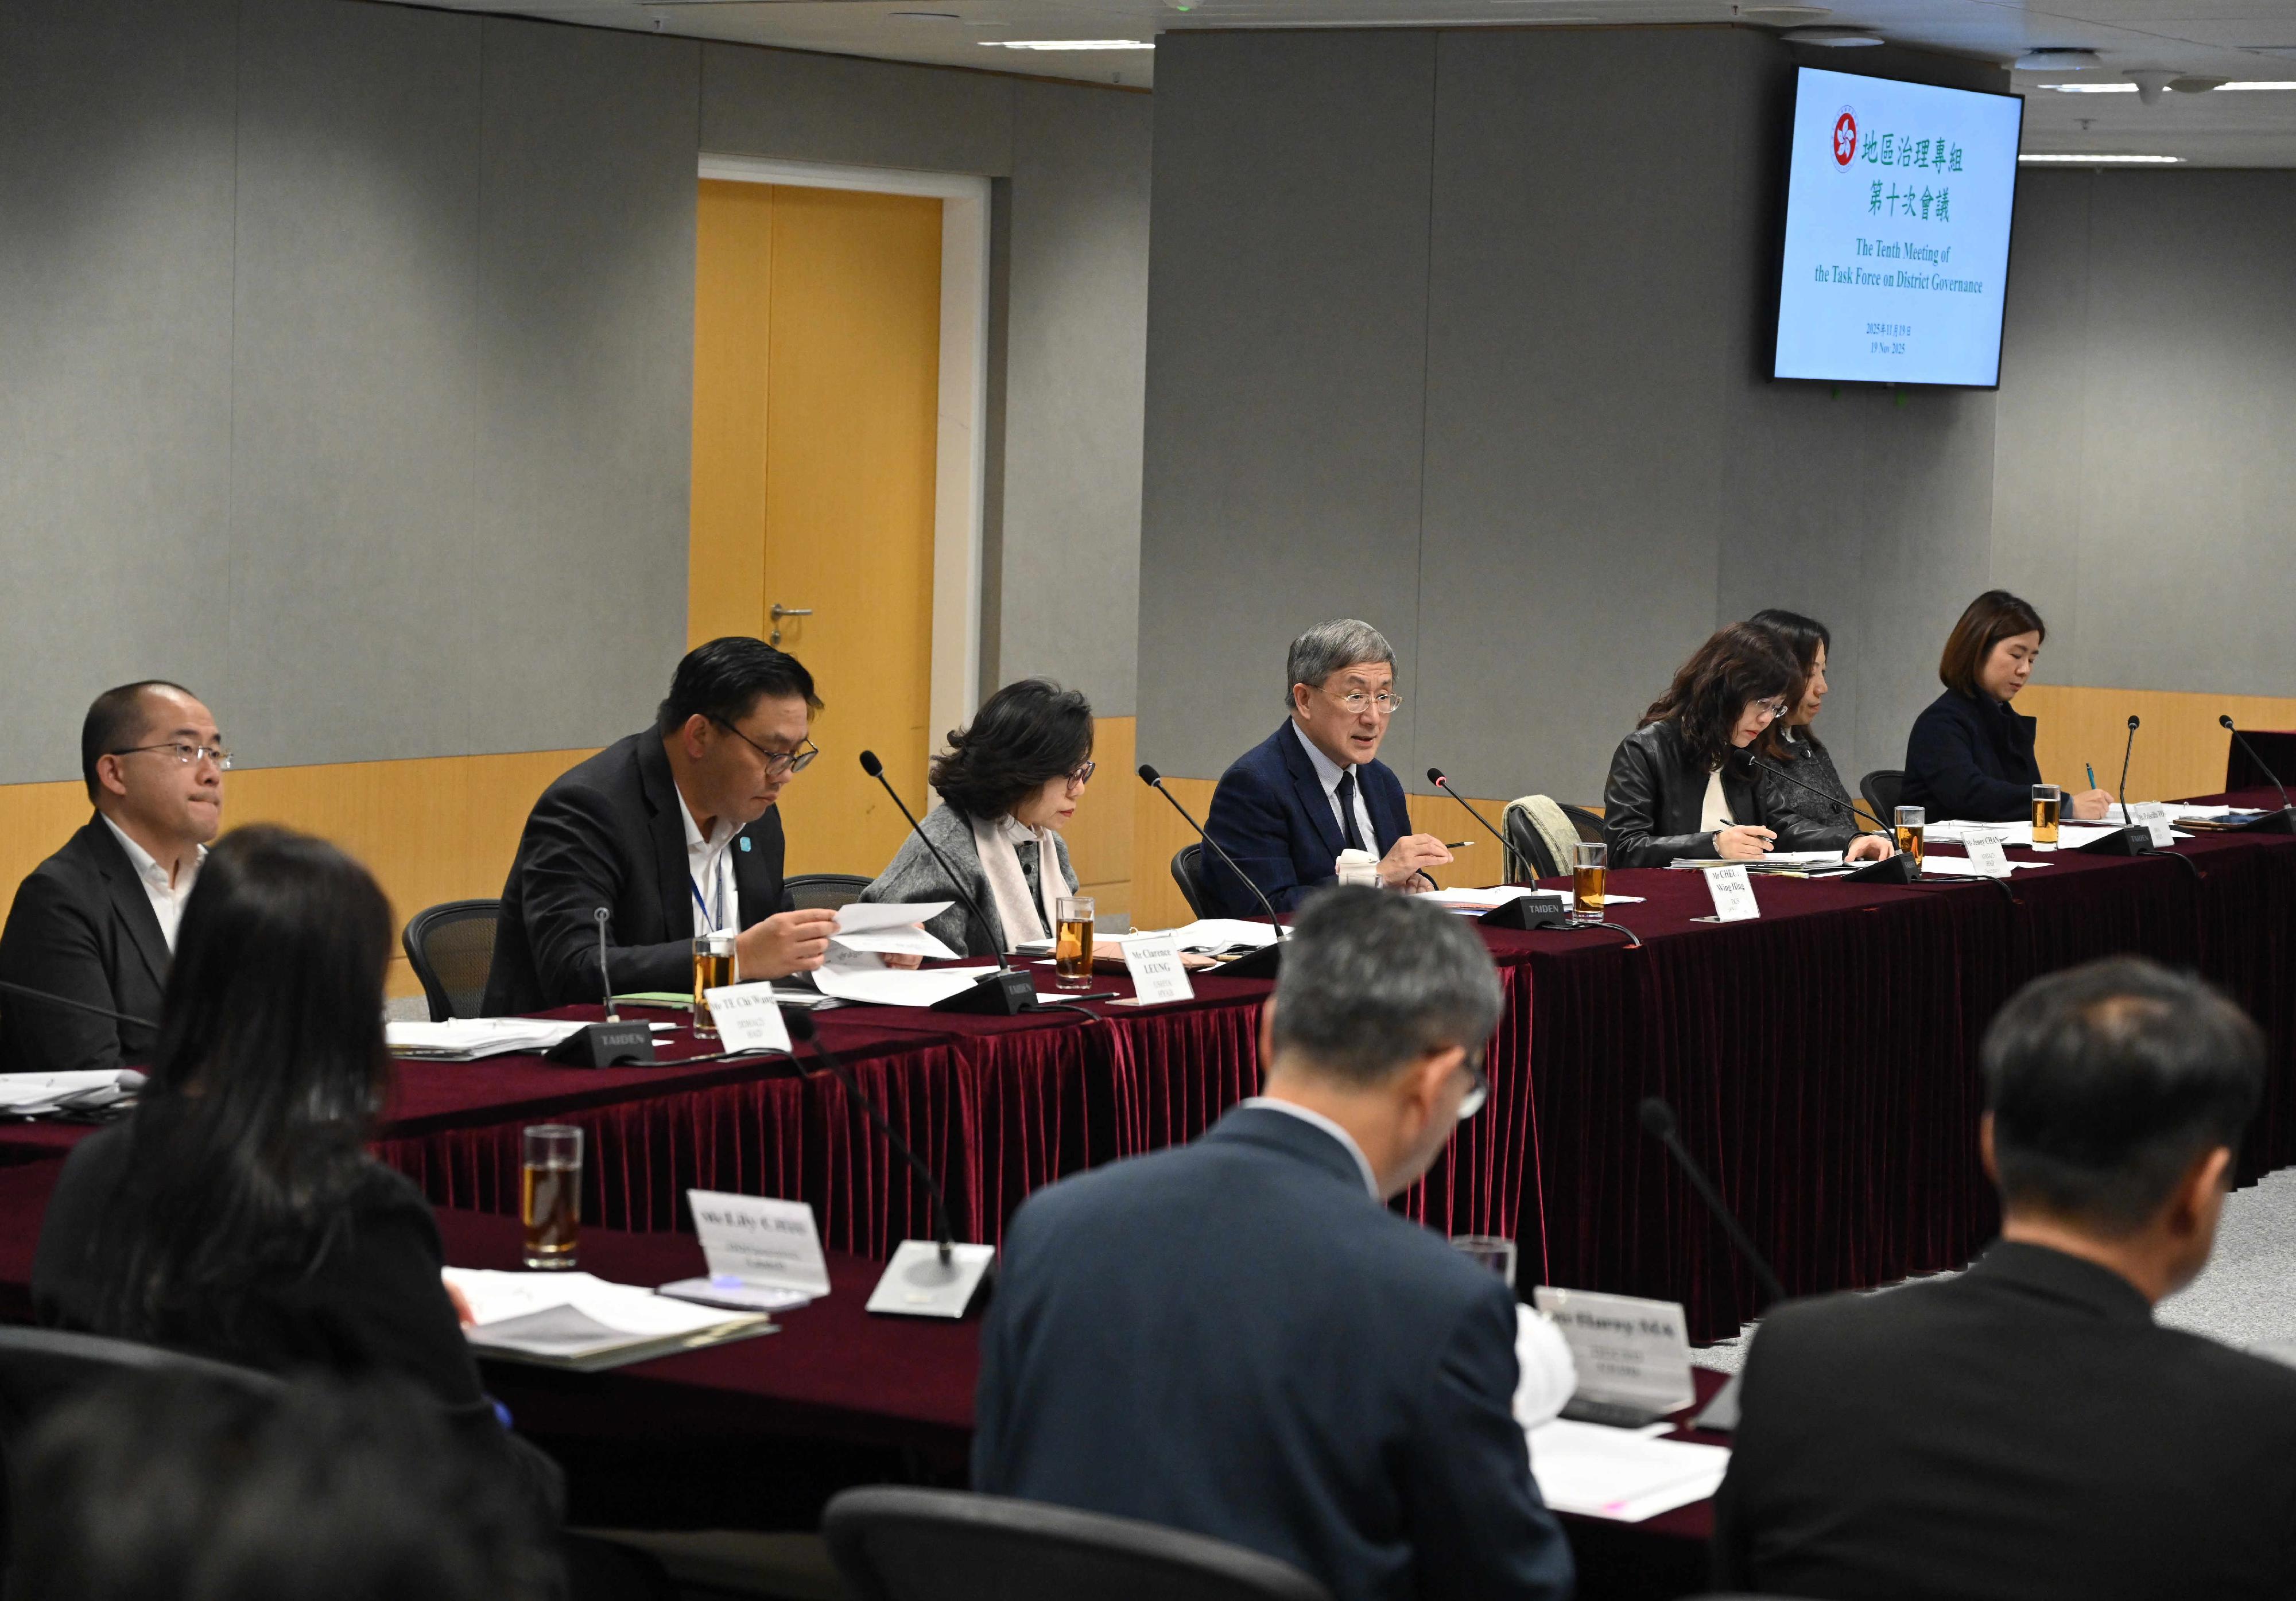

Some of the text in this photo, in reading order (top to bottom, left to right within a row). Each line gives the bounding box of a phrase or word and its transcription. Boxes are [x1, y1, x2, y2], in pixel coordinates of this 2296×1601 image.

[1861, 129, 1963, 174] 地區治理專組
[1868, 179, 1949, 223] 第十次會議
[1856, 238, 1951, 266] The Tenth Meeting of
[1814, 265, 1983, 293] the Task Force on District Governance
[1865, 322, 1911, 337] 2025年11月19日
[1871, 342, 1905, 354] 19 Nov 2025
[1973, 838, 1985, 846] Jenny
[1985, 837, 2000, 845] CHAN
[1712, 872, 1720, 880] Mr
[1716, 882, 1745, 893] Wing Hing
[1529, 904, 1559, 913] TAIDEN
[1132, 949, 1172, 959] Mr Clarence
[1144, 963, 1170, 974] LEUNG
[600, 1033, 645, 1046] TAIDEN
